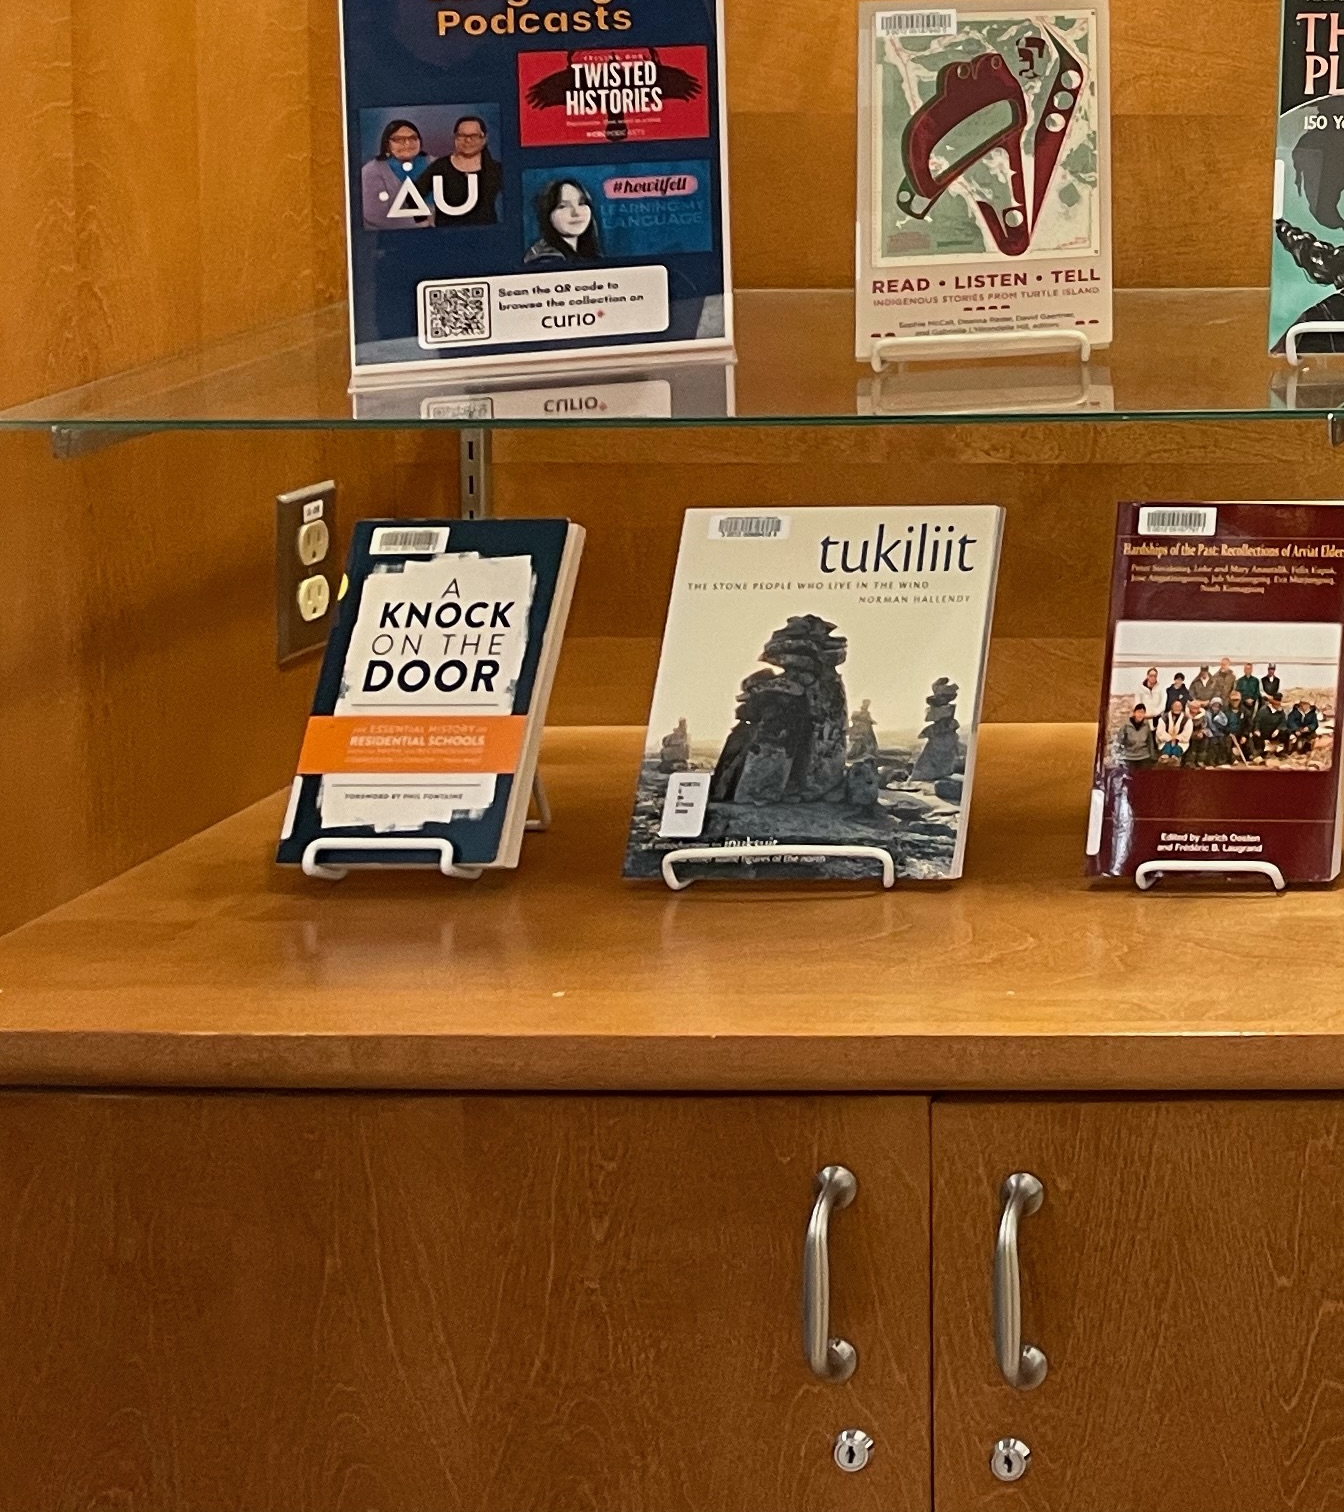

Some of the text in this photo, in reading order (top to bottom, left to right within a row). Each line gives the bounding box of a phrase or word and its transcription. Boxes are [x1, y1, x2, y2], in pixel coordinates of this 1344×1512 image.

[436, 5, 633, 37] Podcasts
[571, 61, 657, 88] TWISTED
[565, 87, 663, 116] HISTORIES
[1303, 115, 1328, 130] 150
[872, 268, 1101, 294] READ LISTEN TELL
[541, 313, 596, 329] curio
[819, 522, 978, 574] tukiliit
[1123, 542, 1168, 559] Hardships
[1170, 542, 1181, 556] of
[1181, 543, 1196, 556] the
[1221, 544, 1279, 556] Recollections
[1281, 544, 1292, 557] of
[1292, 545, 1318, 558] Arviat
[441, 577, 461, 599] A
[858, 595, 971, 604] NORMAN HALLENDY
[379, 601, 515, 629] KNOCK
[371, 633, 506, 656] ON THE
[362, 659, 500, 693] DOOR
[350, 735, 485, 746] RESIDENTIAL SCHOOLS
